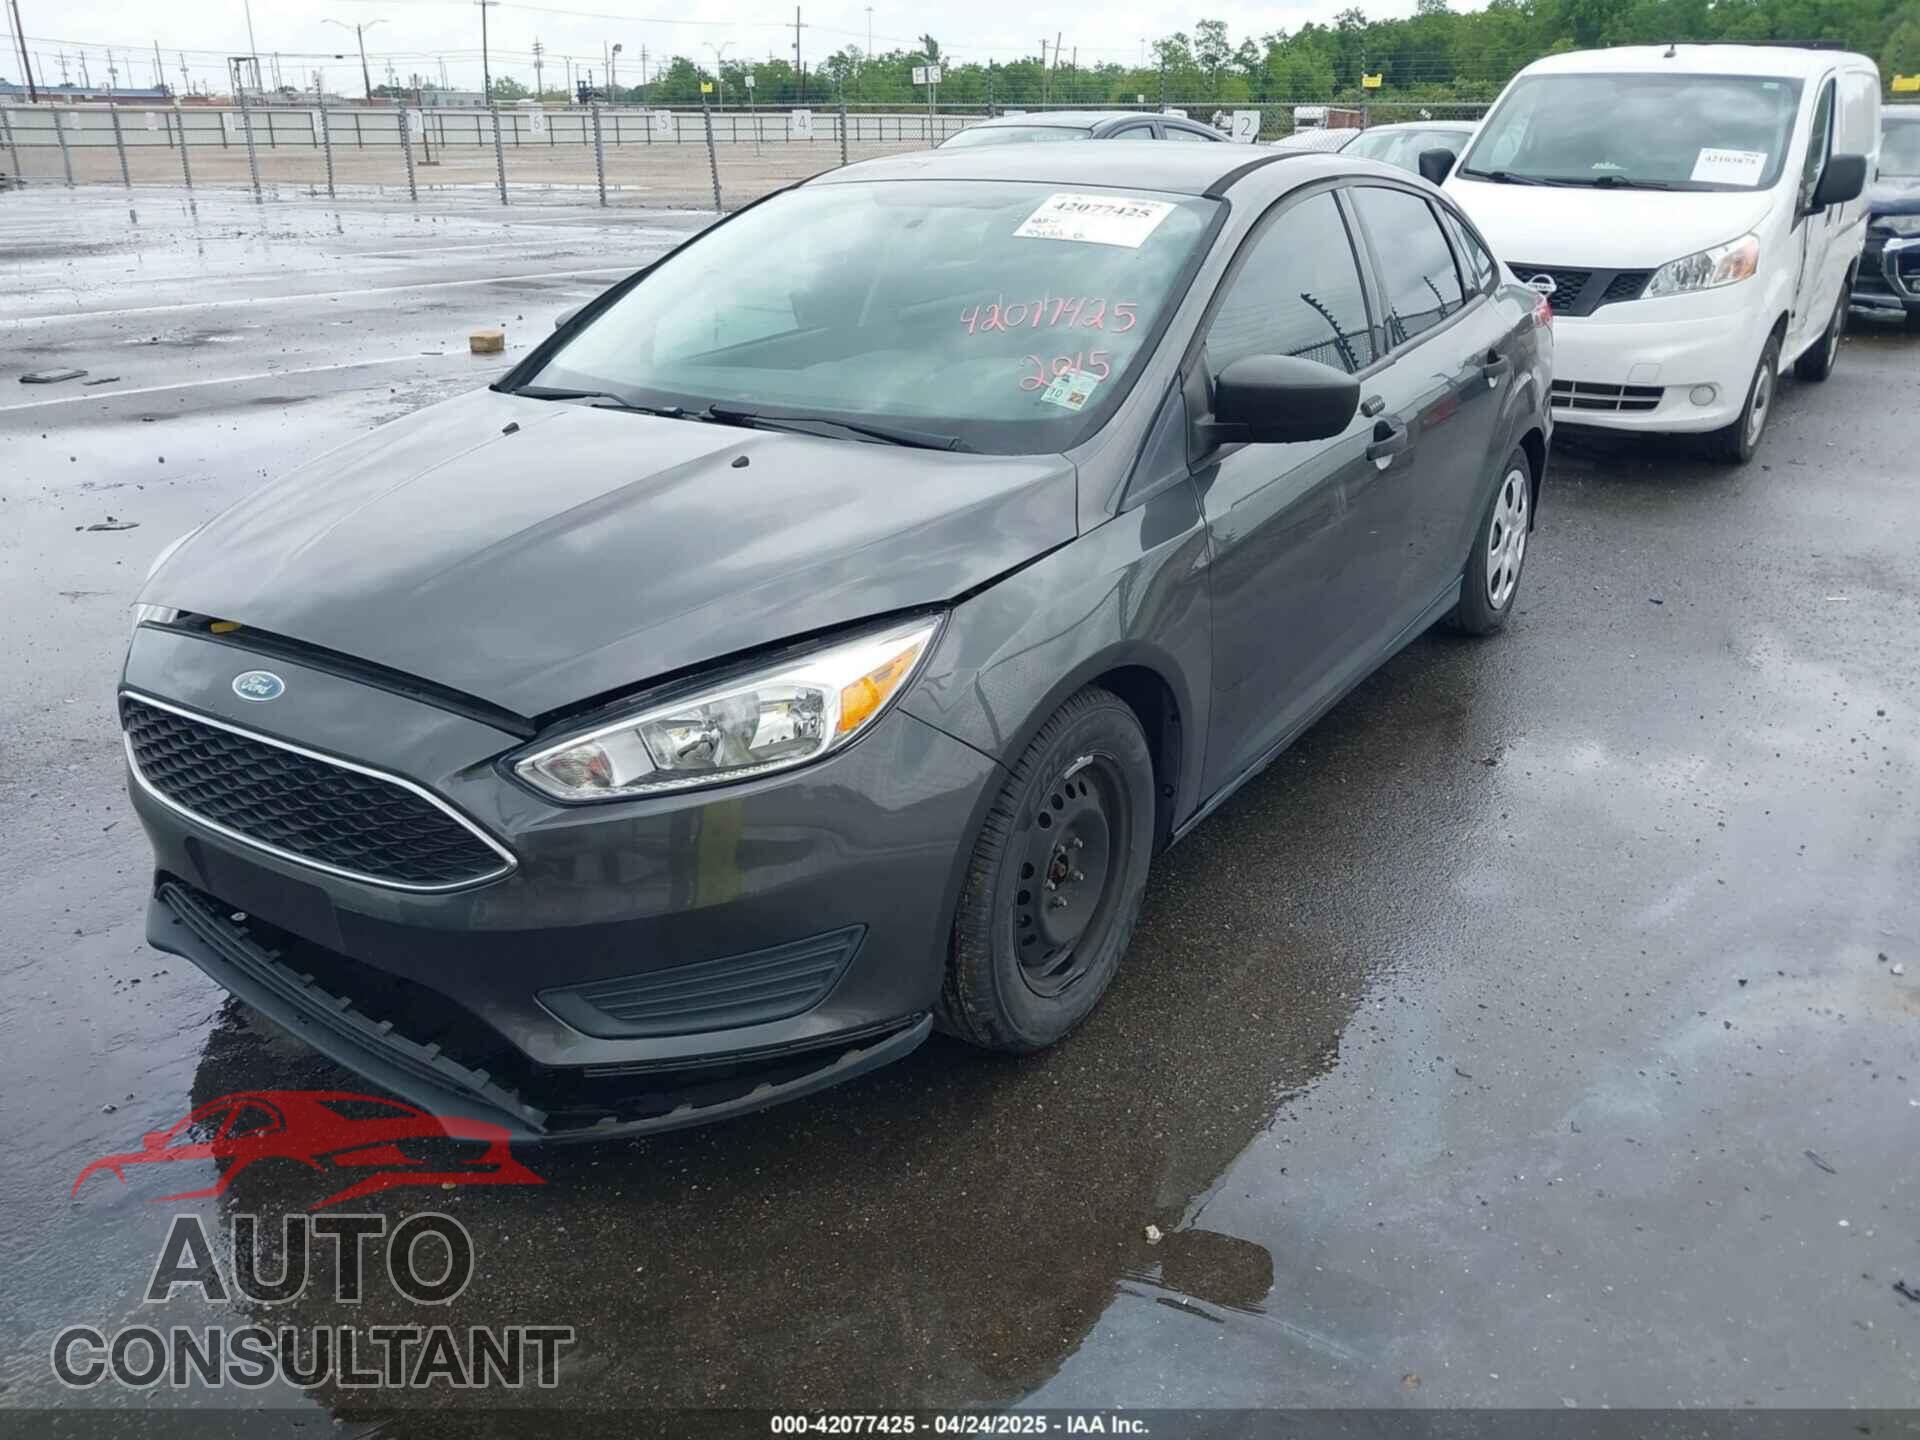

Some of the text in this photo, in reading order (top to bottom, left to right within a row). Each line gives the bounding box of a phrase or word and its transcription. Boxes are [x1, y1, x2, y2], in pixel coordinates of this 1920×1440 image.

[1240, 116, 1251, 136] 2
[1053, 201, 1153, 217] 42077425
[1019, 352, 1110, 390] 2015
